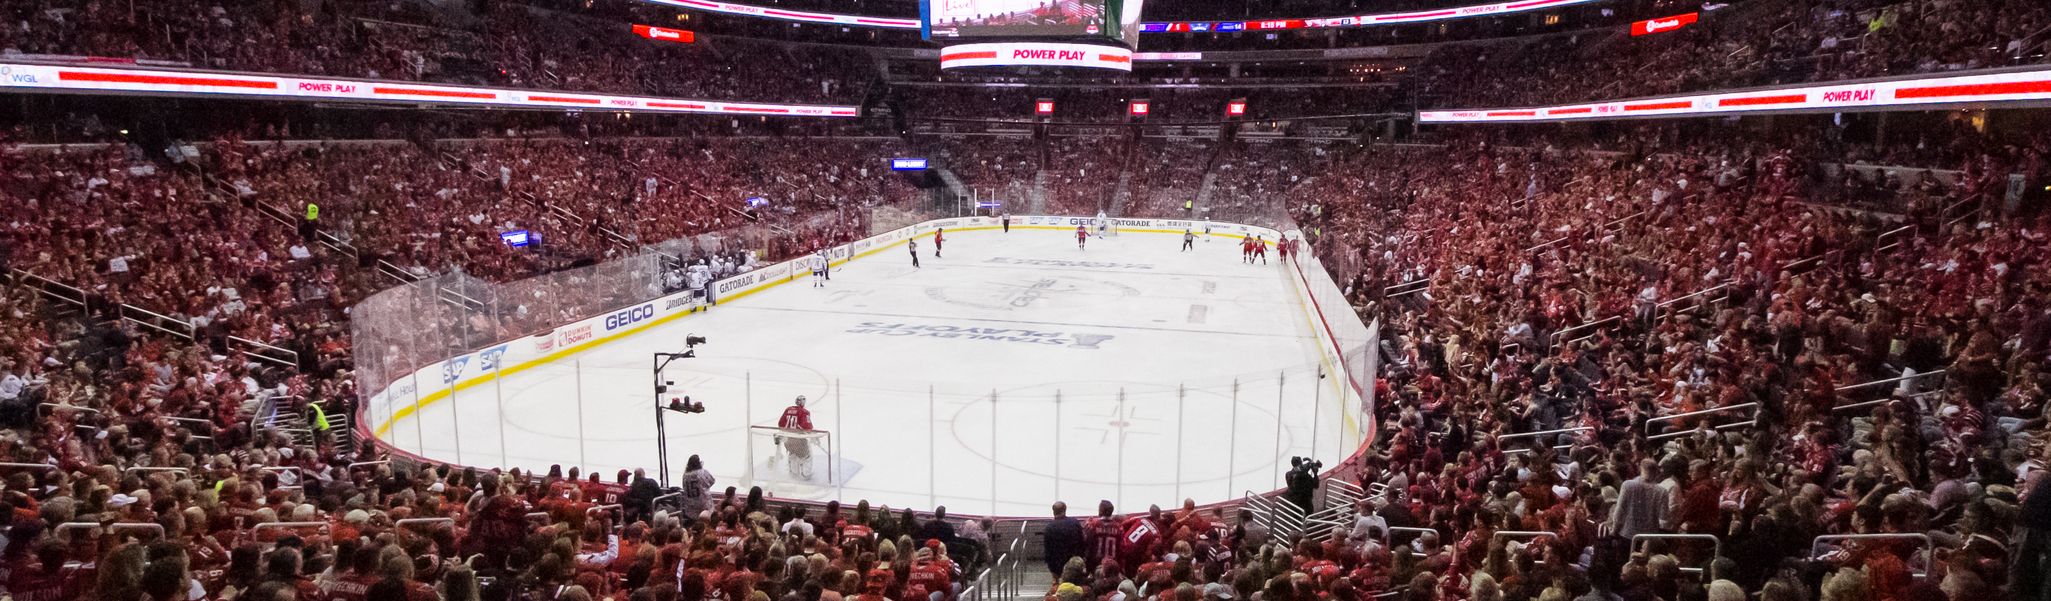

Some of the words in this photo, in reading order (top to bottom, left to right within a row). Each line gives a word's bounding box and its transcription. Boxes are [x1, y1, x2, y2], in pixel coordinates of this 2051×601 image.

[1276, 20, 1287, 28] PM
[1013, 50, 1056, 60] POWER
[1058, 50, 1086, 61] PLAY
[11, 74, 38, 84] WGL
[298, 82, 332, 92] POWER
[335, 84, 356, 93] PLAY
[1823, 90, 1852, 102] POWER
[1853, 89, 1875, 101] PLAY
[1070, 218, 1097, 226] GEIC
[1111, 219, 1151, 227] GATORADE
[719, 274, 754, 294] GATORADE
[665, 294, 693, 311] BRIDGES
[605, 303, 654, 331] GEICO
[857, 321, 1064, 338] PLAYOFFS
[568, 331, 592, 345] DONUTS
[919, 332, 1067, 346] STANLEY
[480, 350, 505, 369] SAP
[443, 360, 466, 382] SAP
[786, 415, 798, 429] 70
